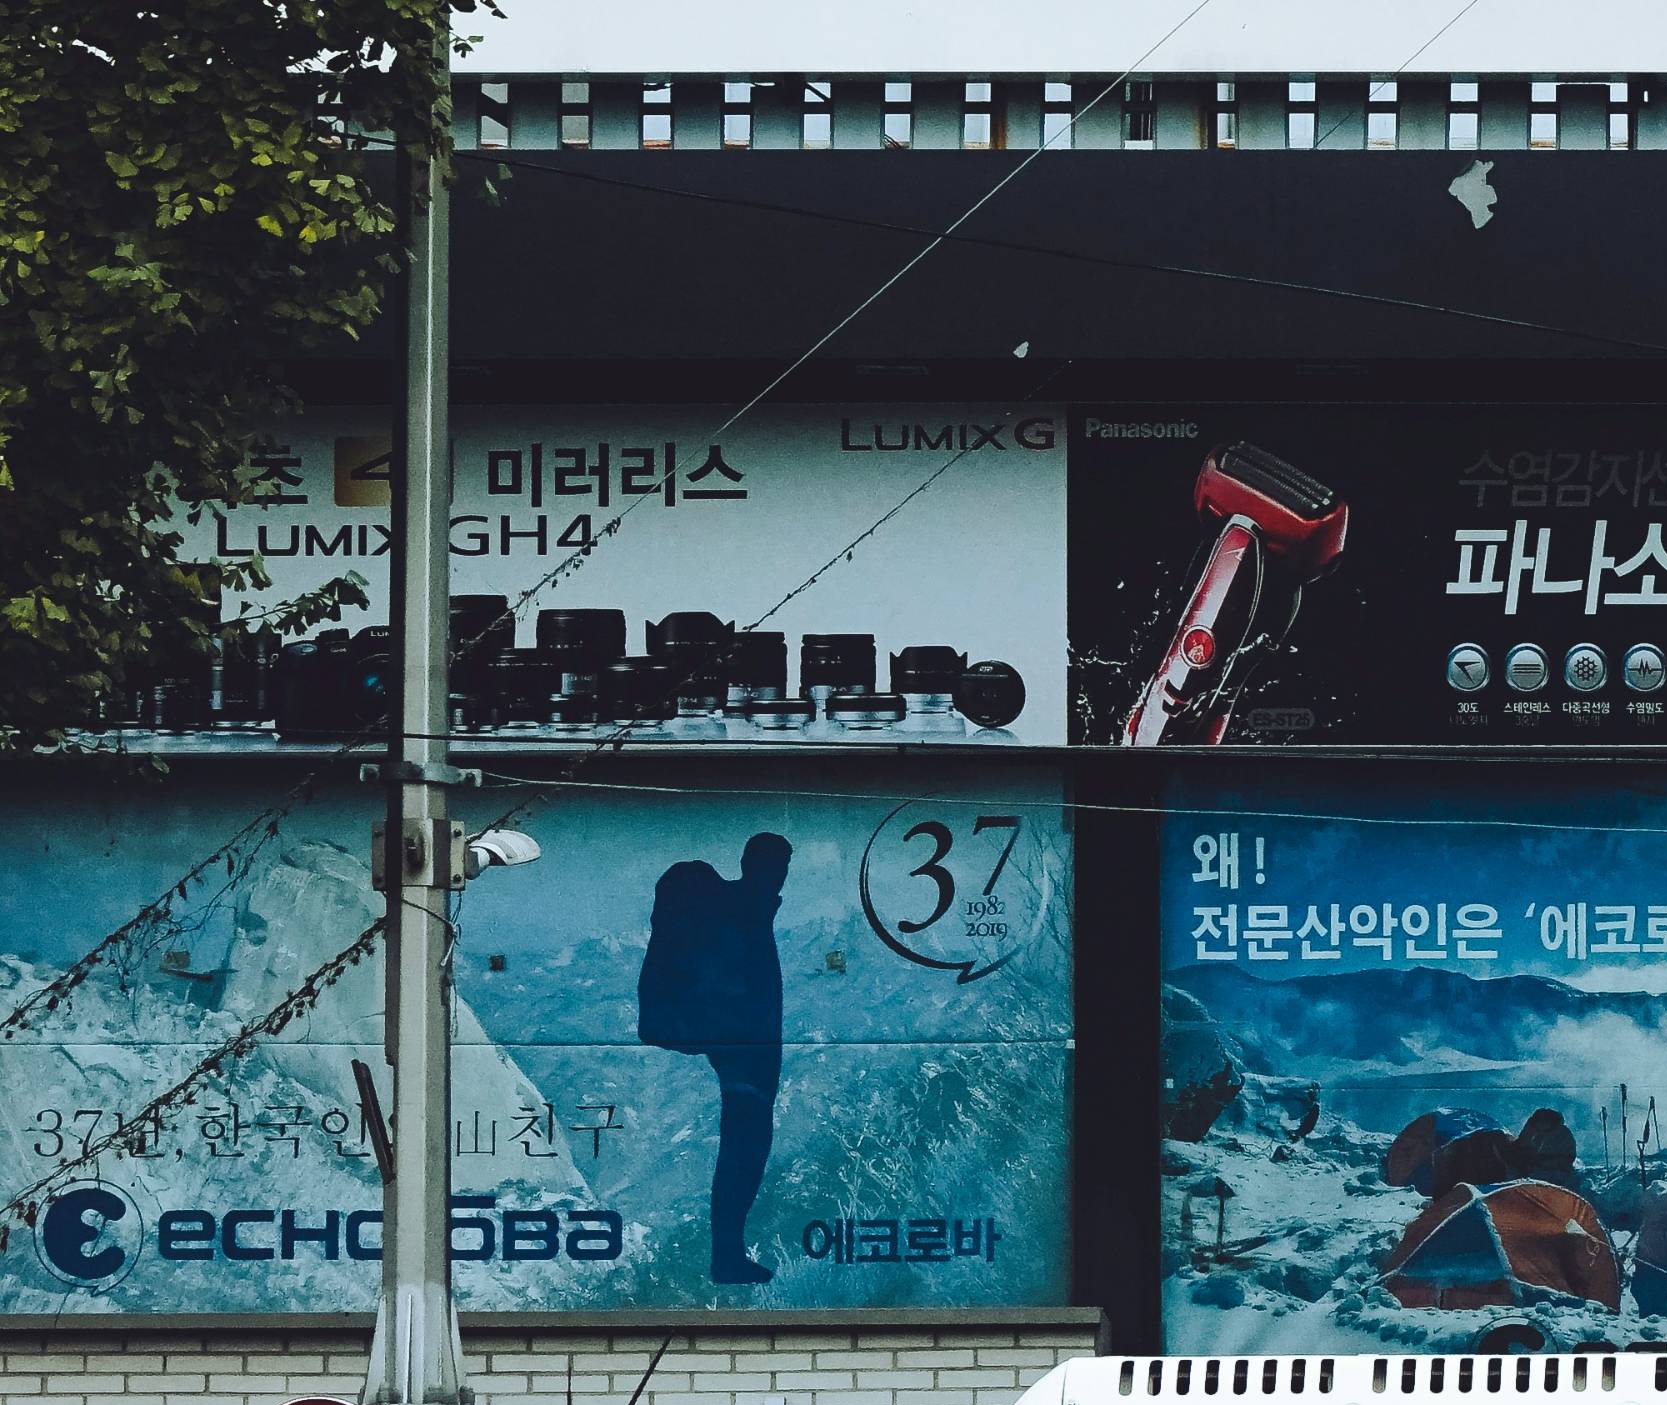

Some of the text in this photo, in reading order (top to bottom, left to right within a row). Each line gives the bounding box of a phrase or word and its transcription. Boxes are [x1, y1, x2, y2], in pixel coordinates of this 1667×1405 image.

[841, 416, 1056, 451] LUMIX G
[1085, 417, 1199, 439] Panasonic
[487, 442, 748, 508] 미러리스
[966, 895, 1005, 920] 1982
[965, 922, 1008, 943] 2019
[1191, 903, 1502, 961] 전문산악인은
[802, 1217, 1003, 1265] 에코로바
